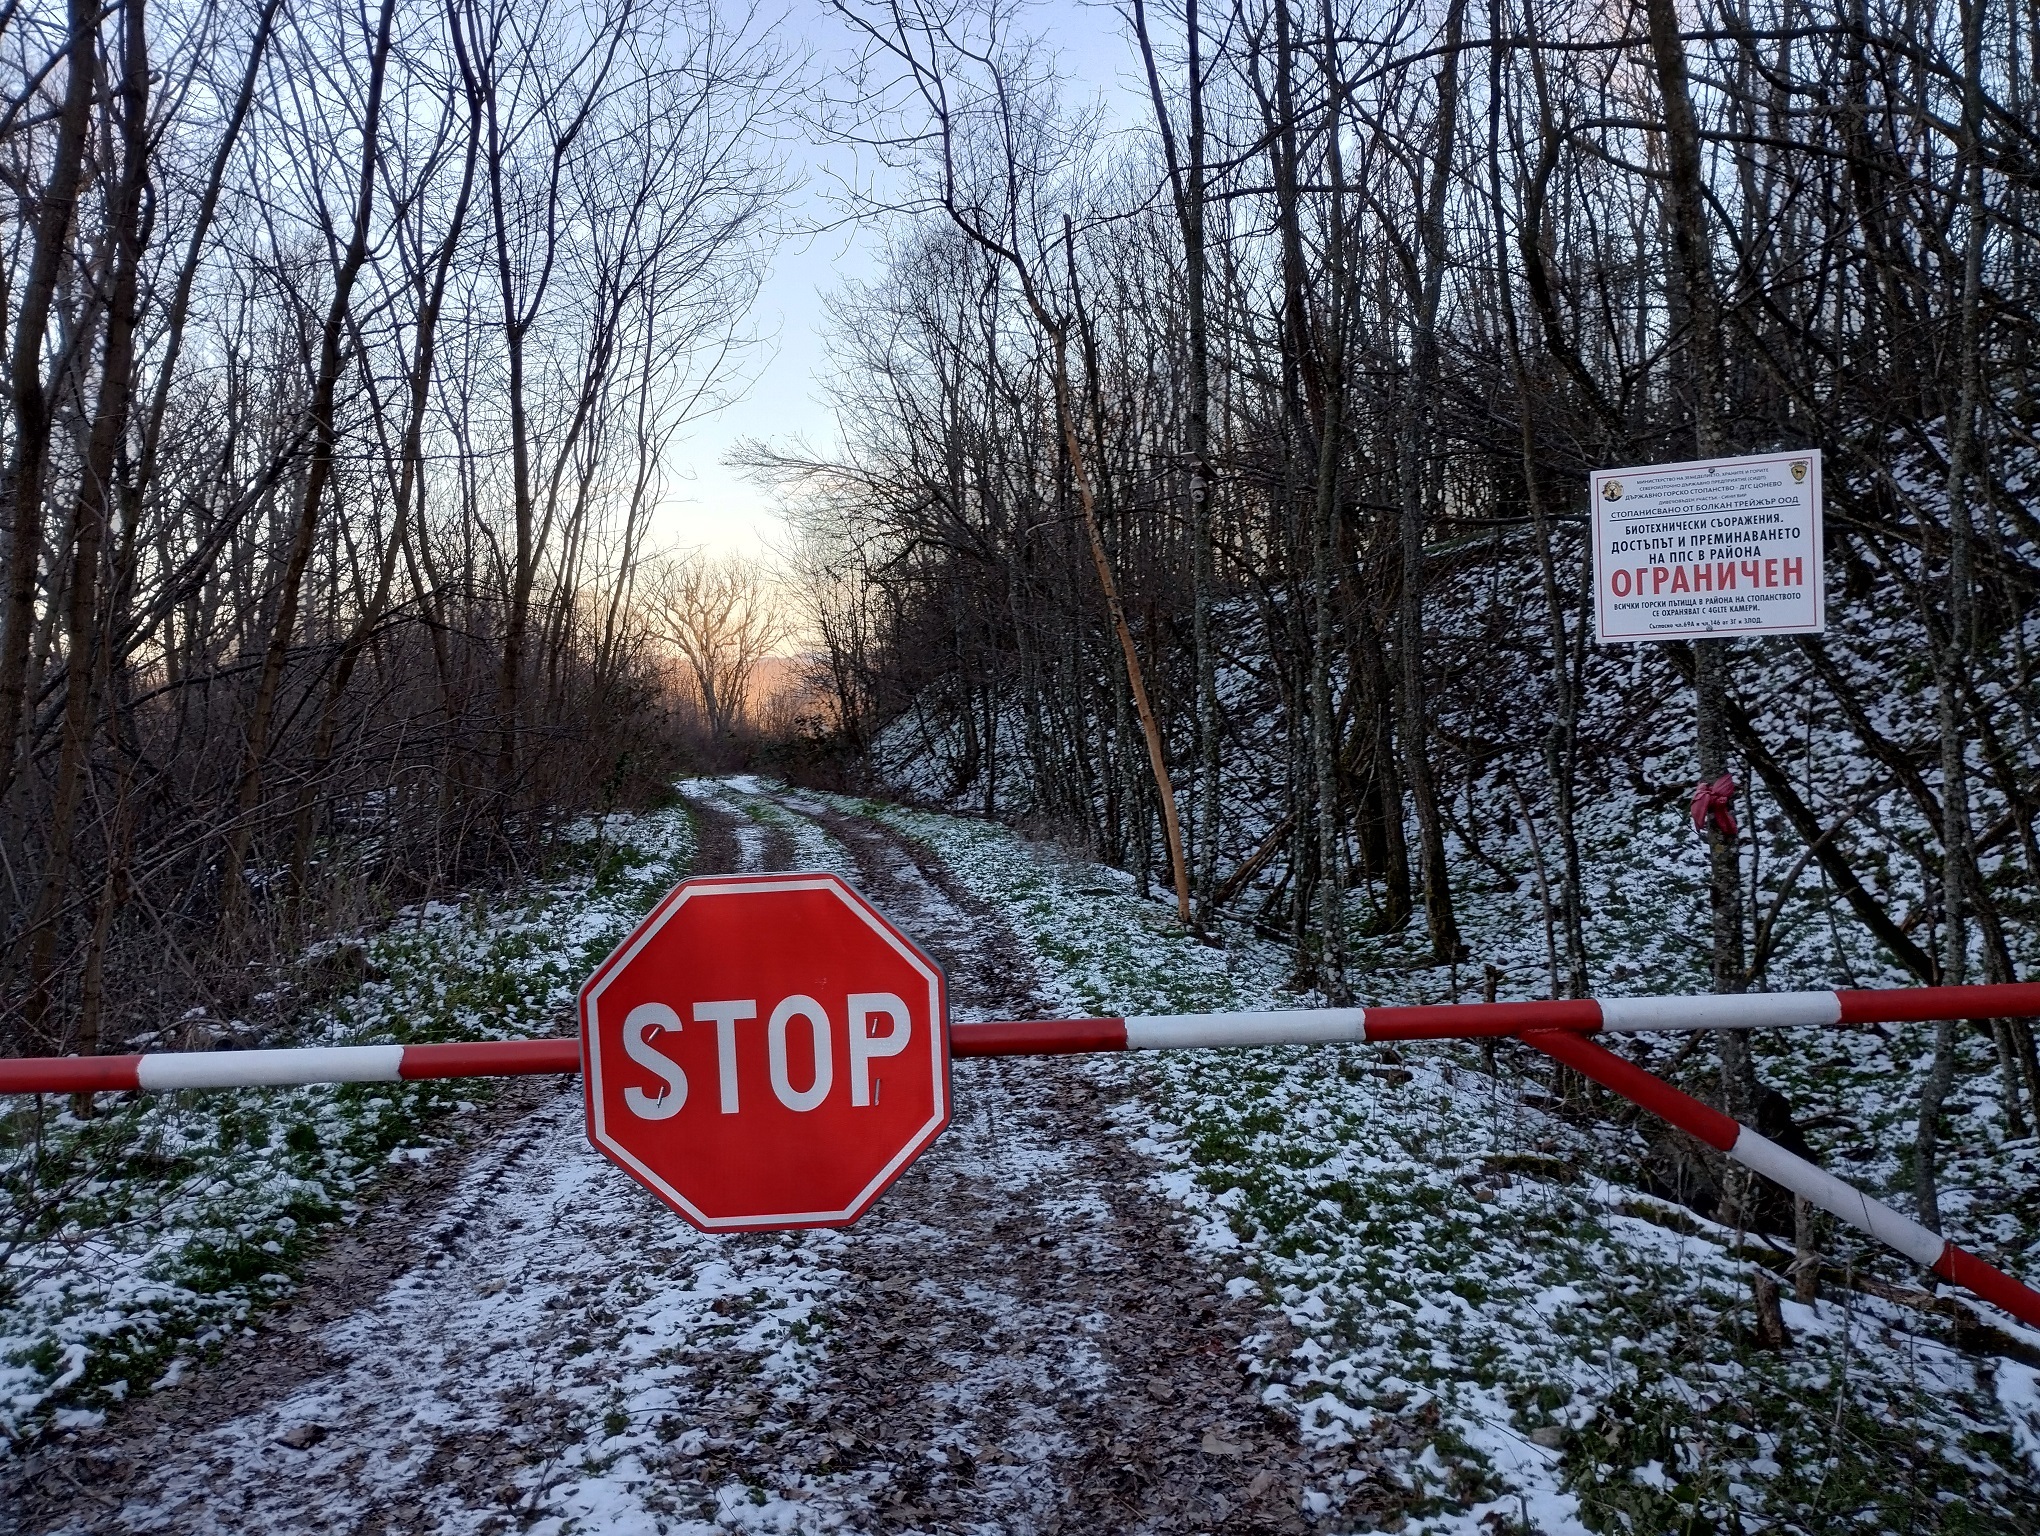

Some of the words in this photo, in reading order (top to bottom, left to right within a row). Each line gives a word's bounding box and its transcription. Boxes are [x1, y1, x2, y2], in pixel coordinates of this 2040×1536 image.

[1690, 486, 1734, 494] СТОПАНСТВО
[1754, 481, 1782, 489] ЦОНЕВО
[1611, 506, 1680, 519] СТОПАНИСВАНО
[1696, 502, 1732, 511] БОЛКАН
[1735, 498, 1776, 507] ТРЕЙЖЪР
[1626, 520, 1706, 535] БИОТЕХНИЧЕСКИ
[1711, 514, 1784, 528] СЪОРАЖЕНИЯ.
[1612, 537, 1673, 554] ДОСТЪПЪТ
[1678, 536, 1686, 547] И
[1691, 528, 1800, 547] ПРЕМИНАВАНЕТО
[1649, 552, 1665, 564] НА
[1669, 550, 1693, 563] ППС
[1699, 550, 1704, 560] В
[1710, 545, 1761, 560] РАЙОНА
[1612, 557, 1802, 597] ОГРАНИЧЕН
[1661, 607, 1700, 616] ОХРАНЯВАТ
[1708, 606, 1727, 614] 4GLTE
[1730, 604, 1760, 612] КАМЕРИ.
[1668, 599, 1697, 608] ПЪТИЩА
[1706, 596, 1732, 604] РАЙОНА
[1747, 592, 1801, 602] СТОПАНСТВОТО
[622, 992, 912, 1121] STOP
